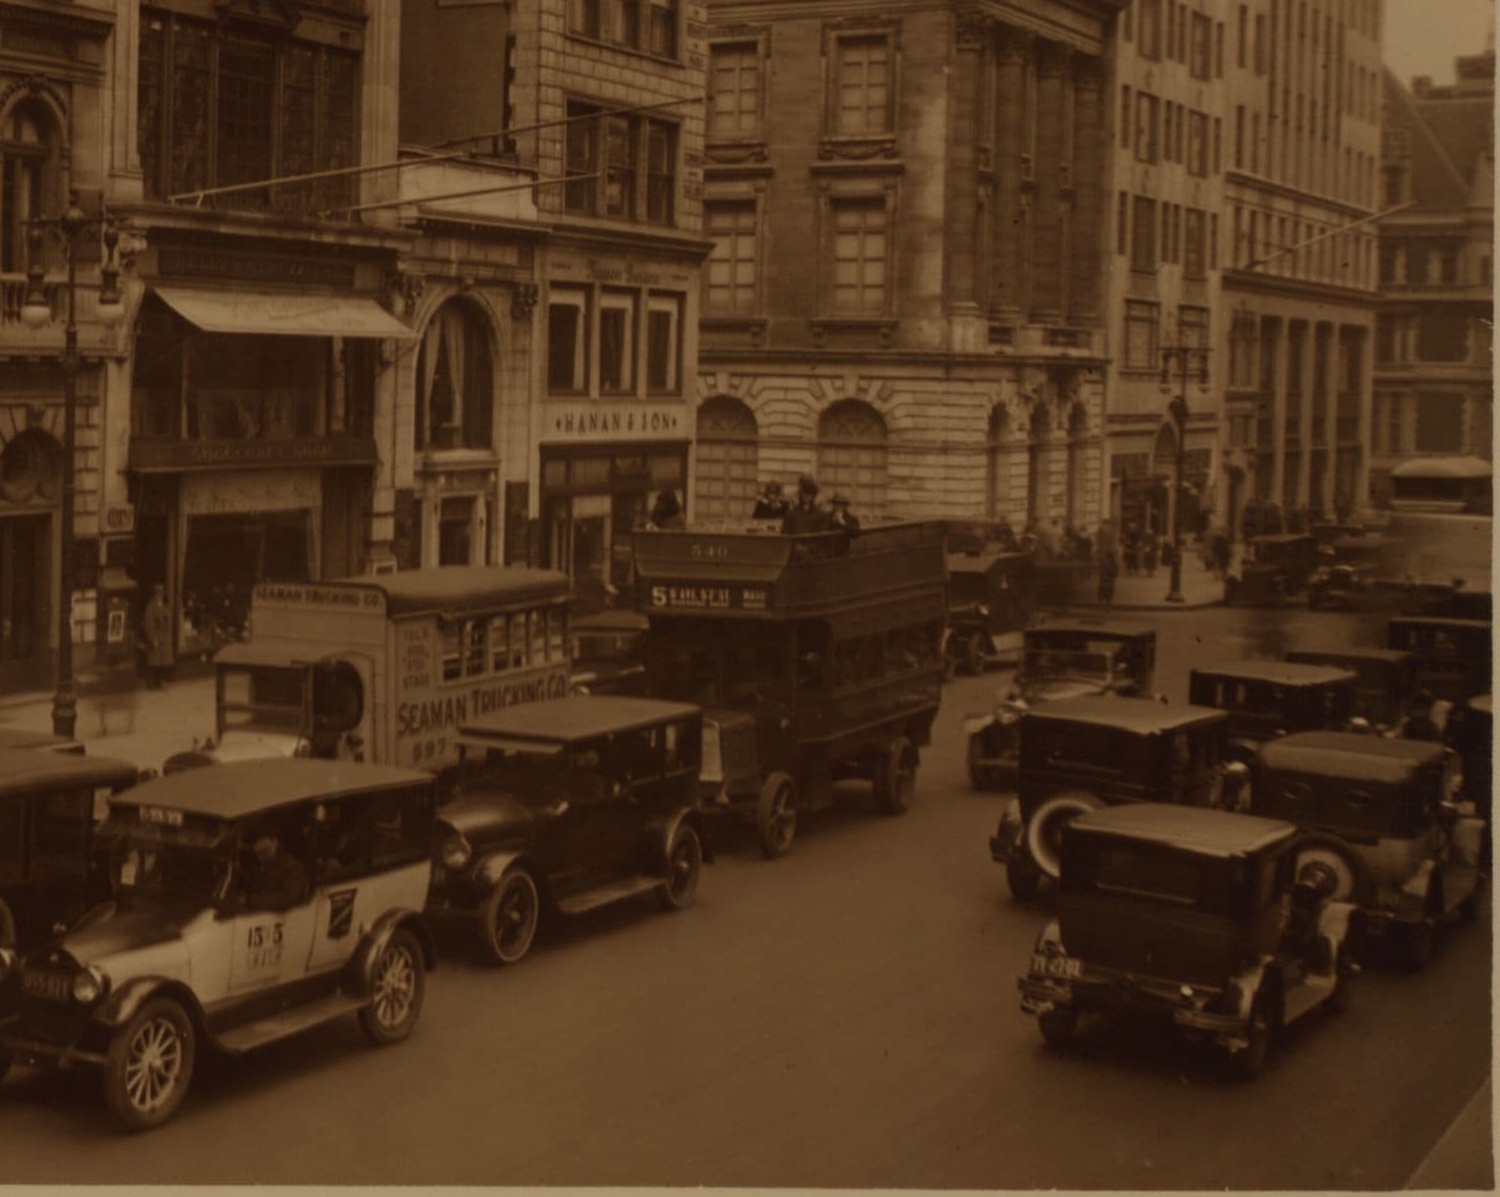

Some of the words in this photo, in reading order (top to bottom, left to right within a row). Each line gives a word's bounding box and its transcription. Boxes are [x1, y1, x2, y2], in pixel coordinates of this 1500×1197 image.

[564, 411, 620, 434] HANAN
[641, 412, 670, 432] SON
[651, 585, 667, 607] 5
[397, 693, 467, 738] SEAMAN
[470, 677, 545, 717] TRUCKING
